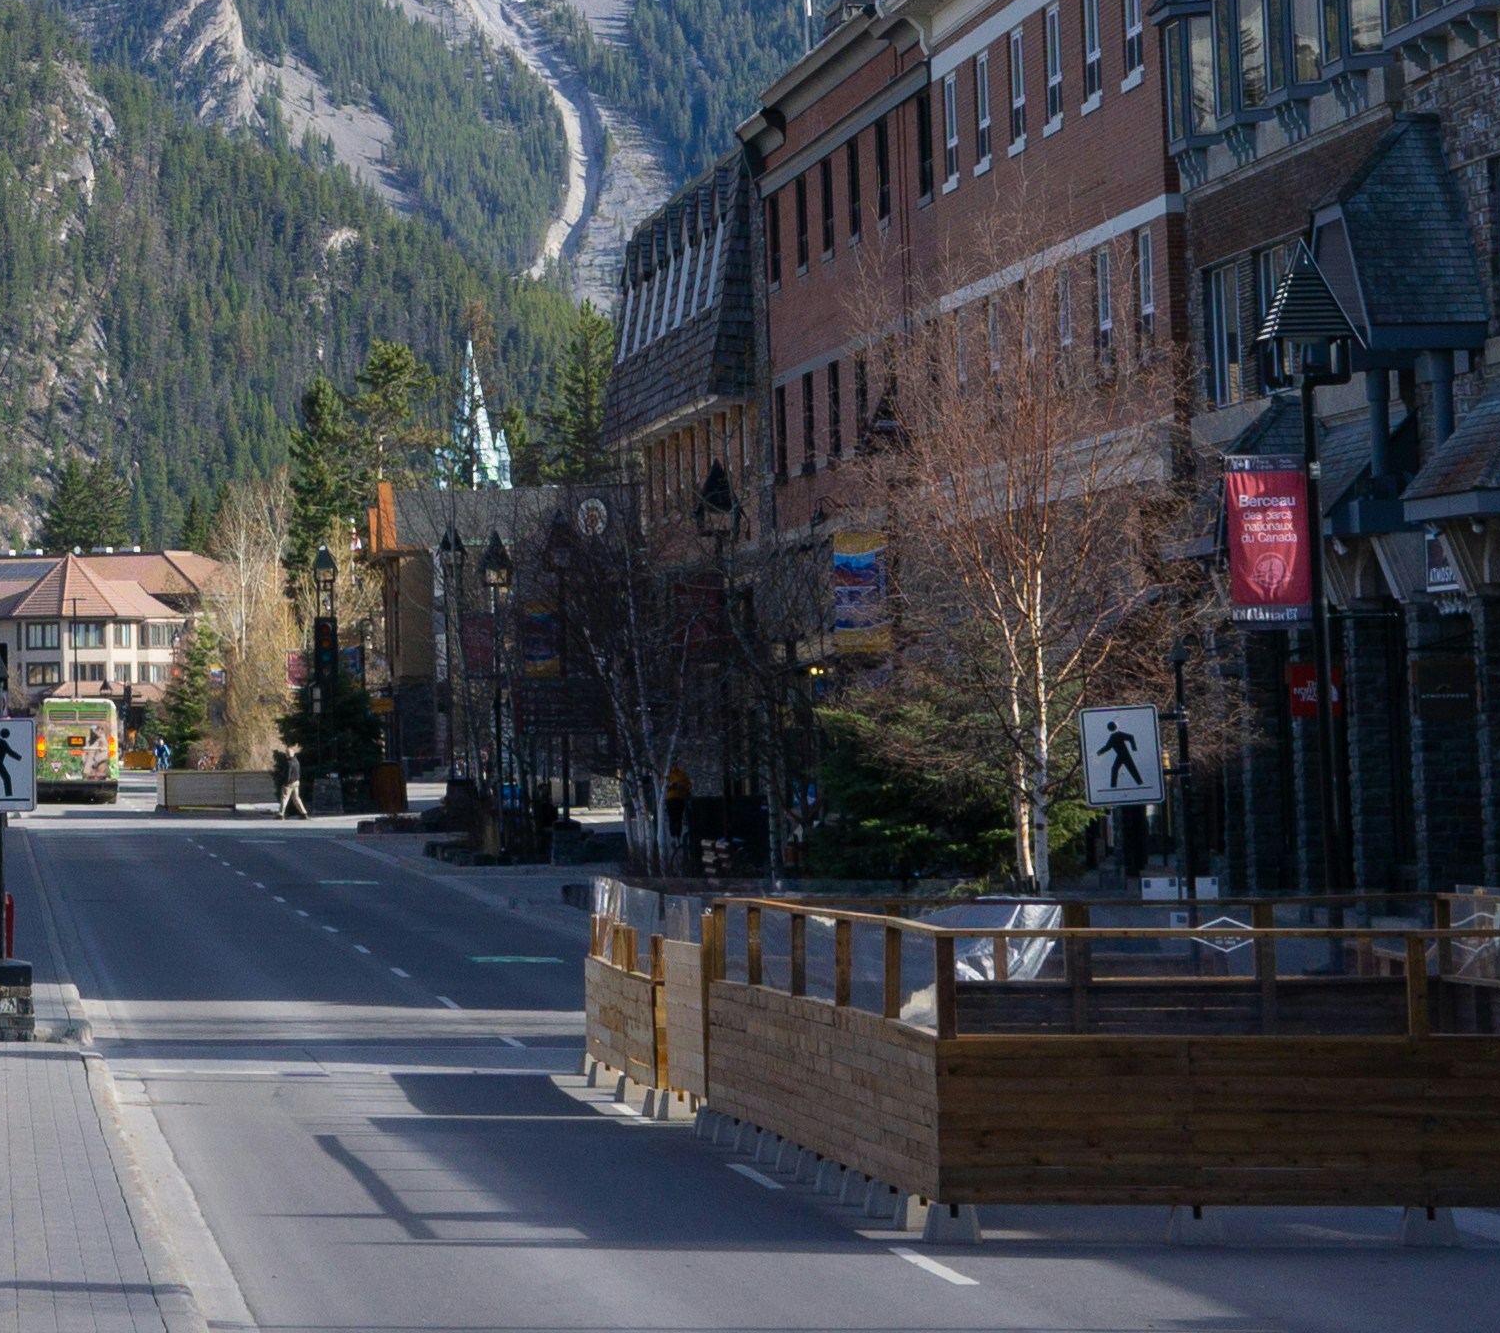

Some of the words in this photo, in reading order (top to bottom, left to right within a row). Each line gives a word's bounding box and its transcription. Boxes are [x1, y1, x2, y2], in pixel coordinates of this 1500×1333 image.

[1238, 494, 1296, 507] Berceau
[1243, 510, 1263, 520] des
[1265, 511, 1293, 522] parcs
[1243, 522, 1294, 531] nationaux
[1241, 533, 1255, 543] du
[1257, 532, 1297, 543] Canada
